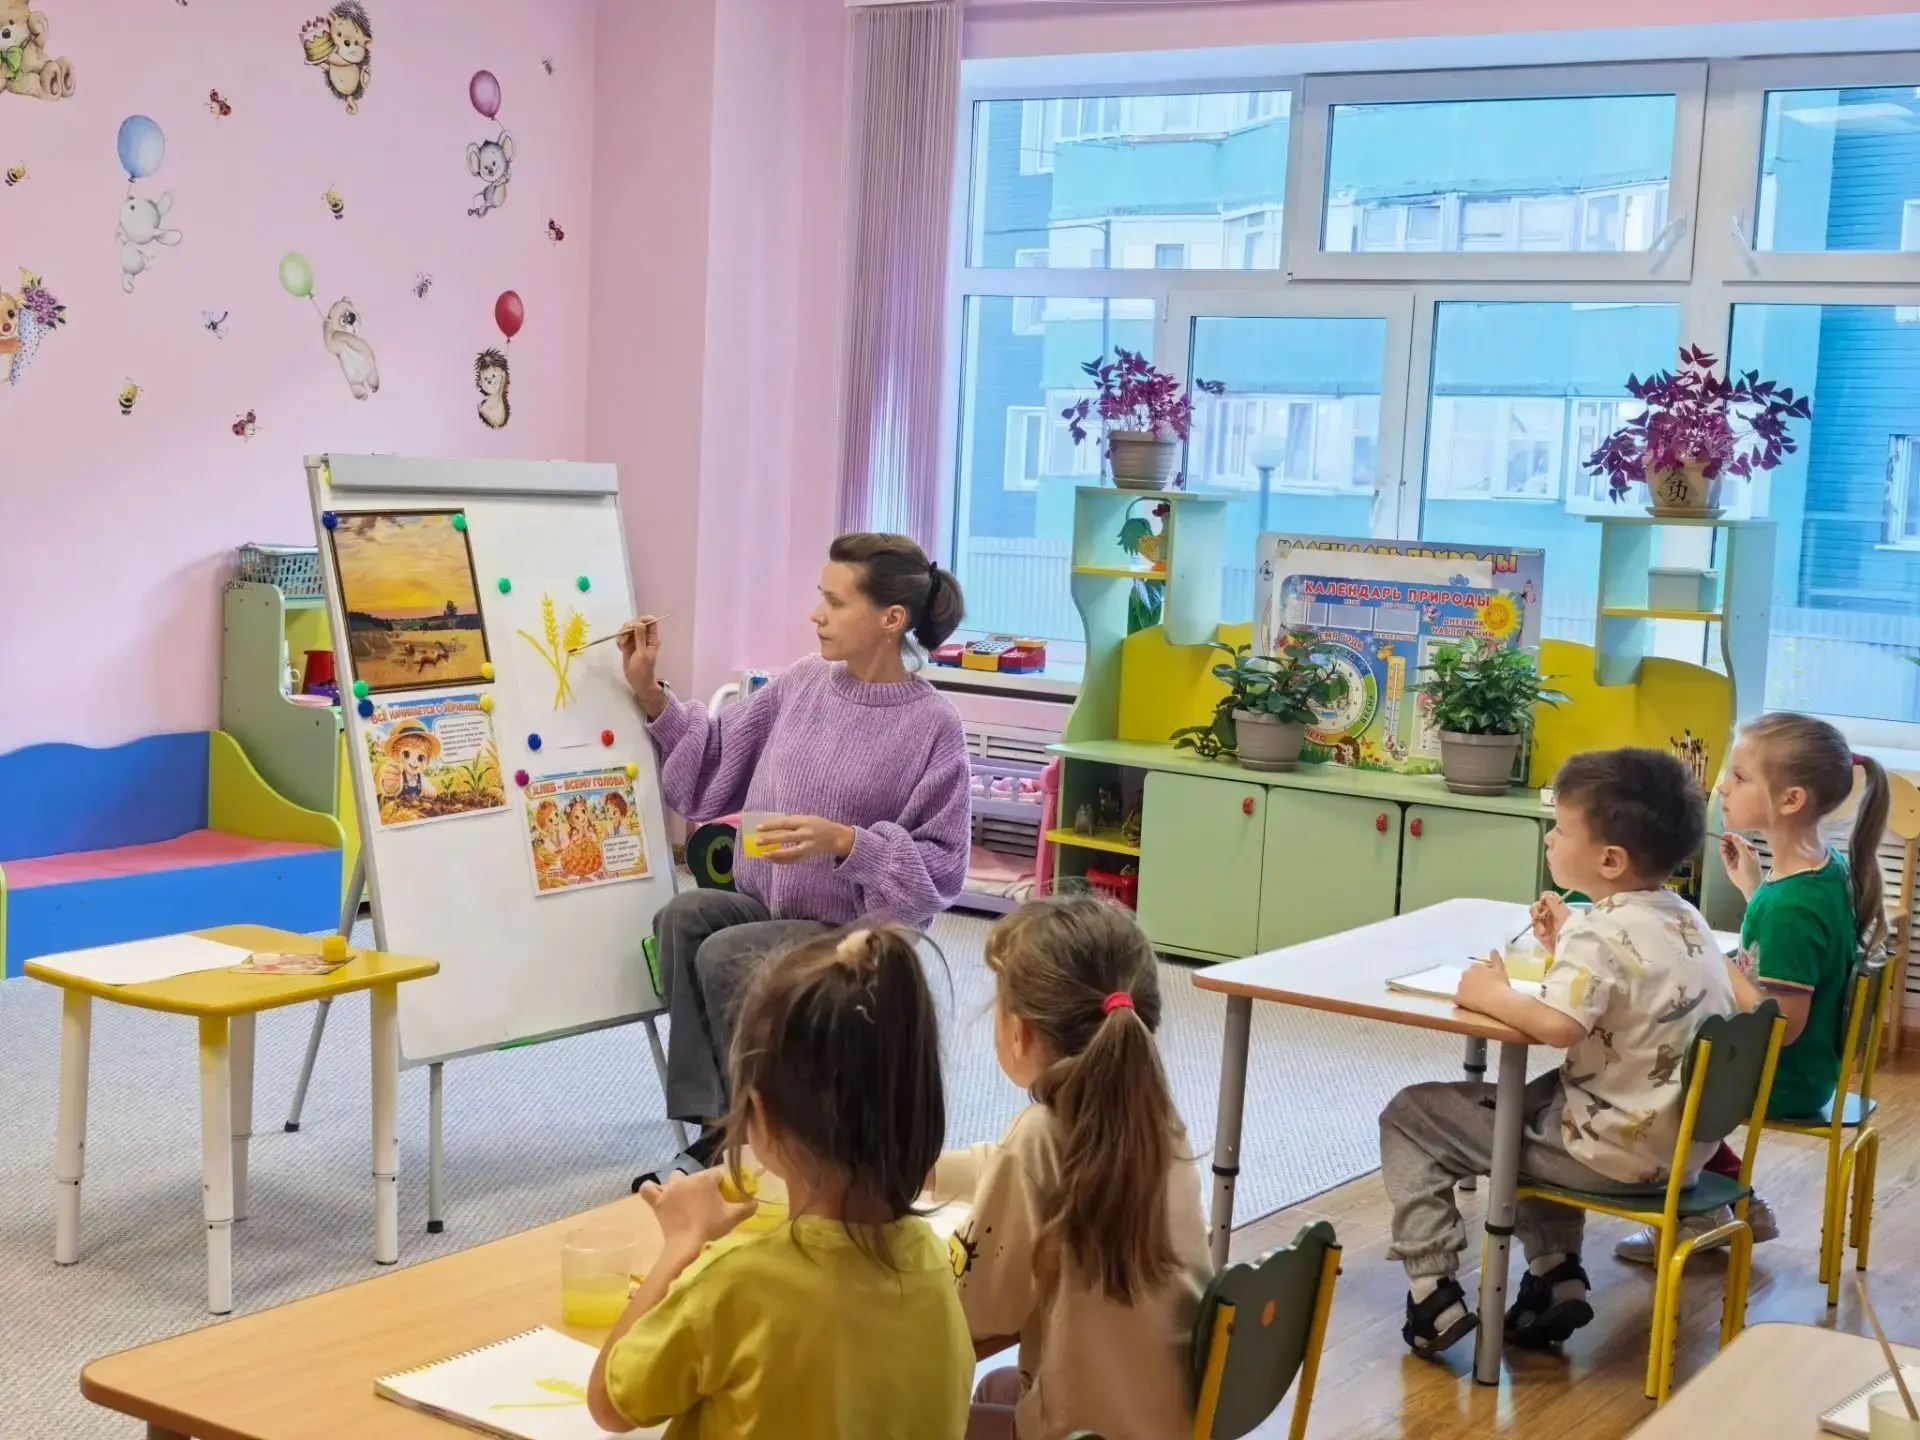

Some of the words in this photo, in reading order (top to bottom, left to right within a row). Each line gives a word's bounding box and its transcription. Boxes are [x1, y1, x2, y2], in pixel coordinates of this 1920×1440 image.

[1304, 580, 1401, 600] КАЛЕНДАРЬ
[1408, 589, 1492, 608] ПРИРОДЫ
[1443, 617, 1485, 627] ДНЕВНИК
[1360, 694, 1375, 724] ВЕСНА
[1304, 727, 1326, 741] ЛЕТО
